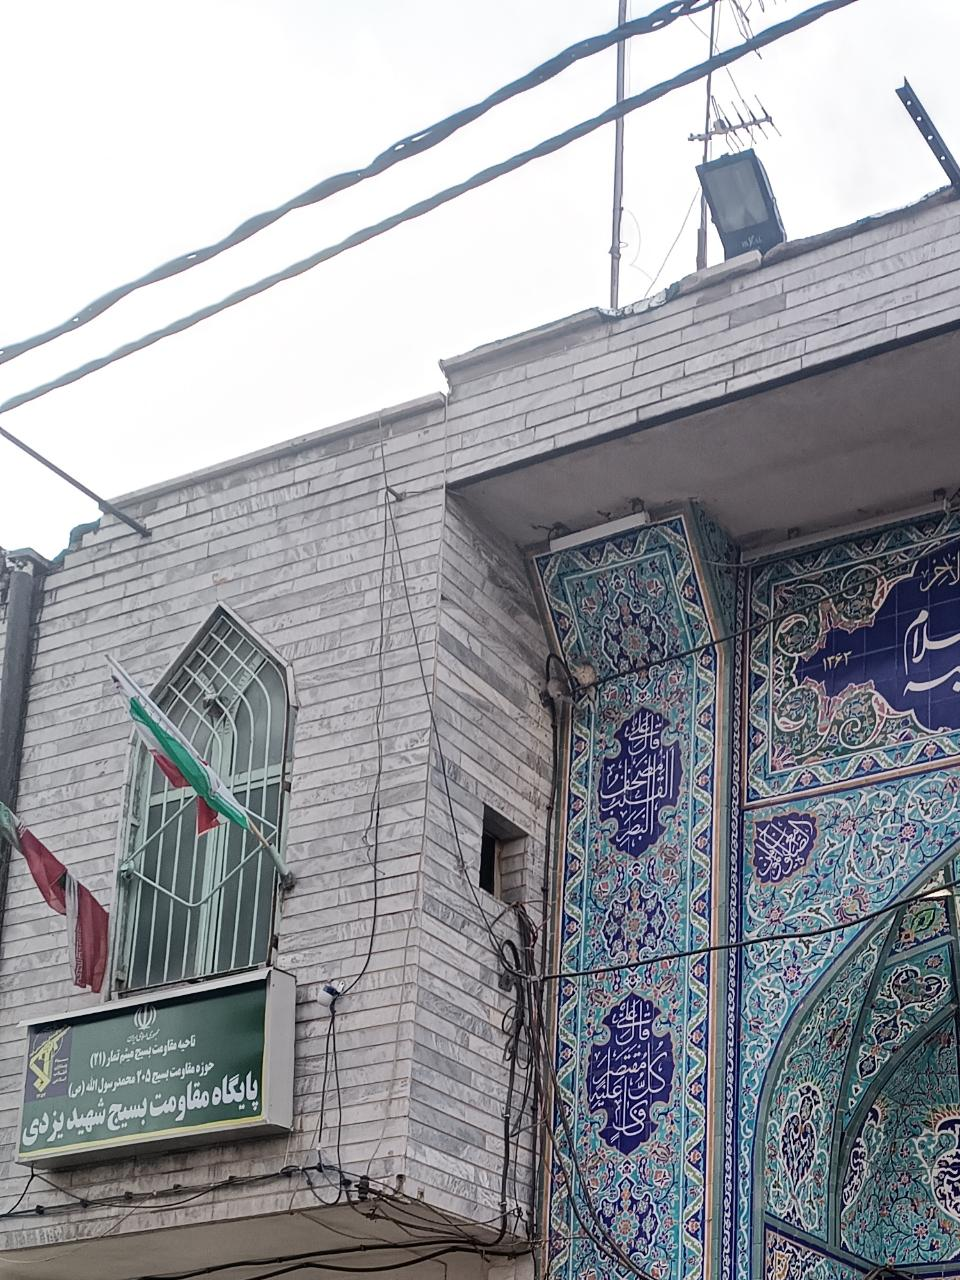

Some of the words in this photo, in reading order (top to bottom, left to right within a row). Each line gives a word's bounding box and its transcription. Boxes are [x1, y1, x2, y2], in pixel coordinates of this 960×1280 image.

[152, 1039, 177, 1057] مقاومت
[177, 1034, 196, 1051] ناحیه
[106, 1052, 120, 1067] تمار
[119, 1050, 134, 1064] میثم
[134, 1046, 152, 1060] بسیج
[136, 1069, 150, 1083] ۲۰۵
[151, 1068, 169, 1083] بسیج
[169, 1062, 195, 1079] مقاومت
[195, 1061, 215, 1076] حوزه
[86, 1077, 98, 1091] الله
[211, 1071, 258, 1112] پایگاه
[149, 1081, 209, 1121] مقاومت
[66, 1098, 105, 1135] شهید
[107, 1097, 148, 1130] بسیج
[22, 1109, 64, 1146] یزدی
